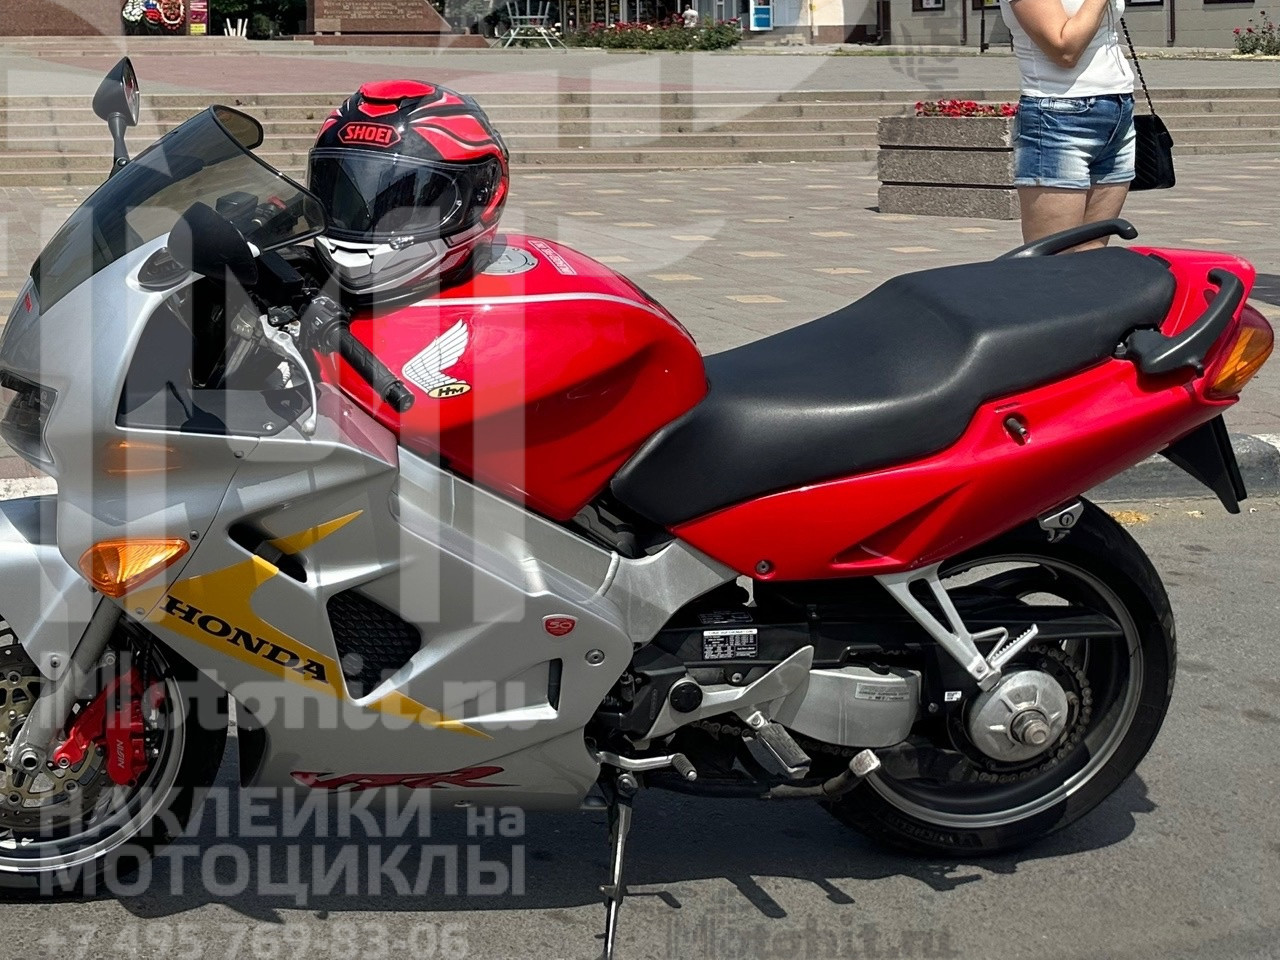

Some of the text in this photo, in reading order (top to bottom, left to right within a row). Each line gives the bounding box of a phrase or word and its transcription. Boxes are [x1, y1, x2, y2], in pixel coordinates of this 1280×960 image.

[344, 124, 393, 145] SHOEI
[437, 386, 464, 397] HM
[159, 595, 329, 685] HONDA
